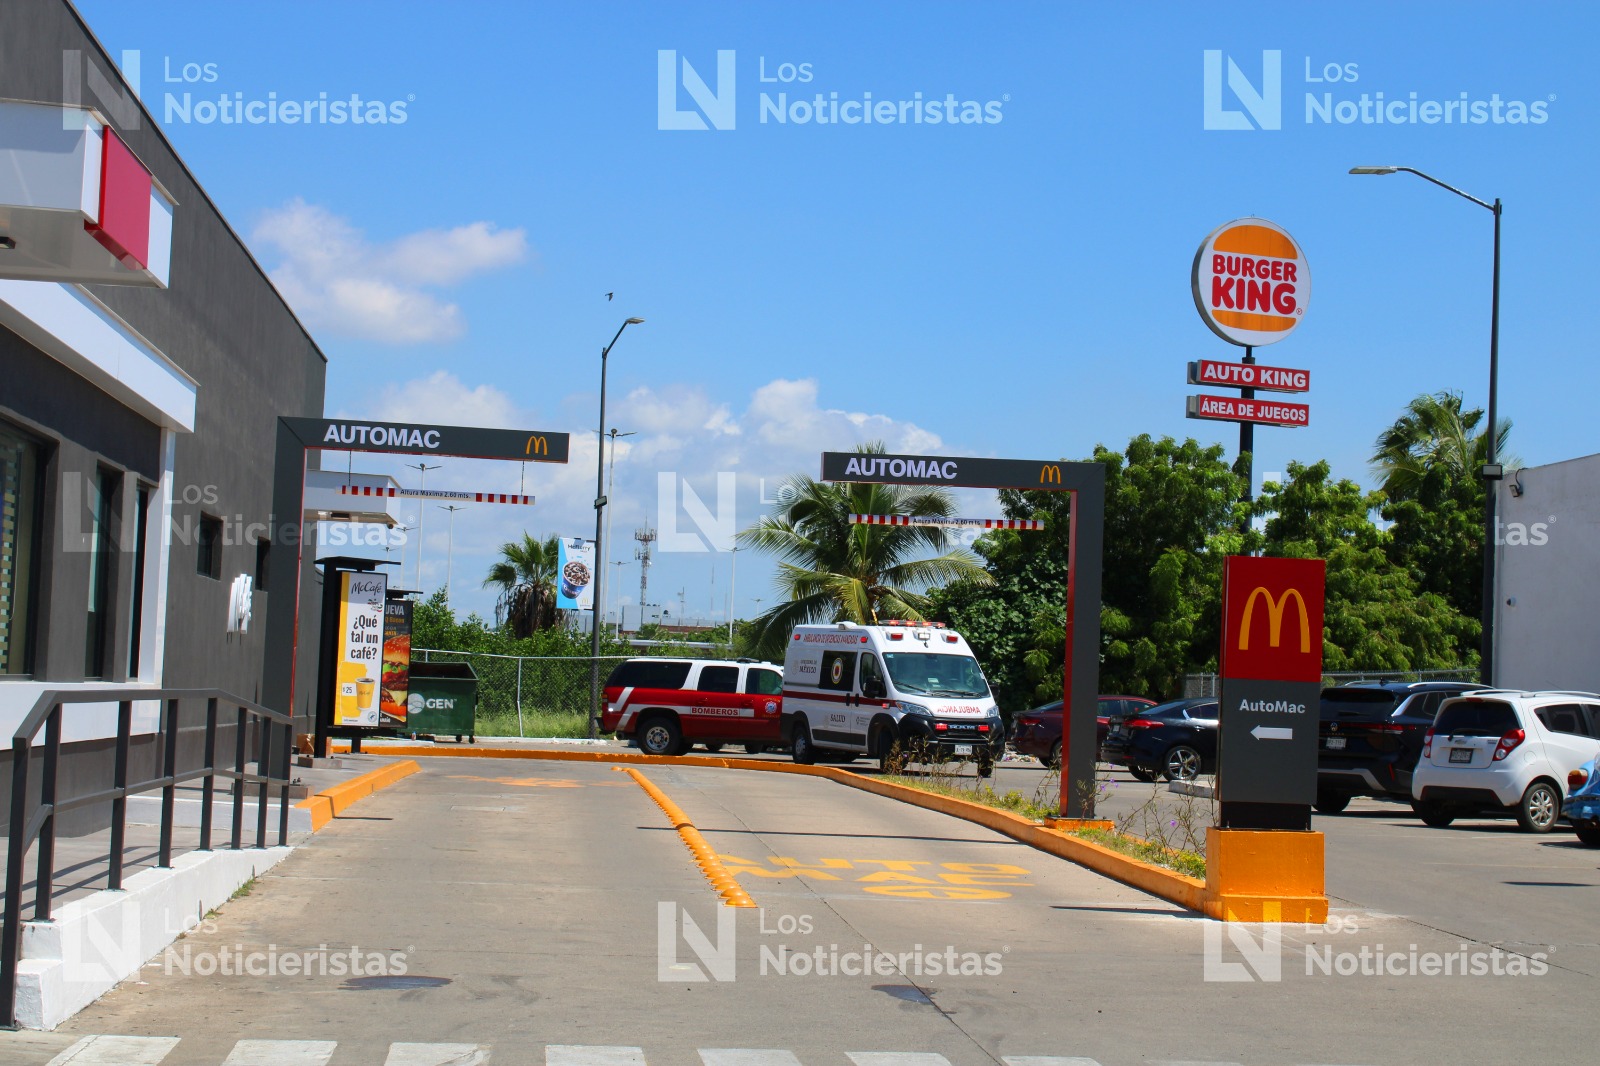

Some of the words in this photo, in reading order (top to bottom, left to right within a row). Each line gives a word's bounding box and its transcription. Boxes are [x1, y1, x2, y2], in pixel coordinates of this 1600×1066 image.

[1213, 254, 1297, 282] BURGER
[1212, 276, 1297, 315] KING
[1204, 363, 1255, 383] AUTO
[1260, 369, 1307, 388] KING
[1201, 398, 1235, 415] ÁREA
[1238, 403, 1254, 417] DE
[1257, 405, 1307, 421] JUEGOS
[323, 423, 441, 449] AUTOMAC
[845, 457, 958, 480] AUTOMAC
[351, 581, 382, 595] McCafé
[384, 604, 404, 615] UEVA
[353, 614, 378, 630] ¿Qué
[351, 630, 364, 643] tal
[366, 633, 379, 644] un
[350, 646, 378, 660] café?
[426, 698, 454, 709] GEN
[691, 707, 739, 716] BOMBEROS
[1239, 698, 1306, 714] AutoMac
